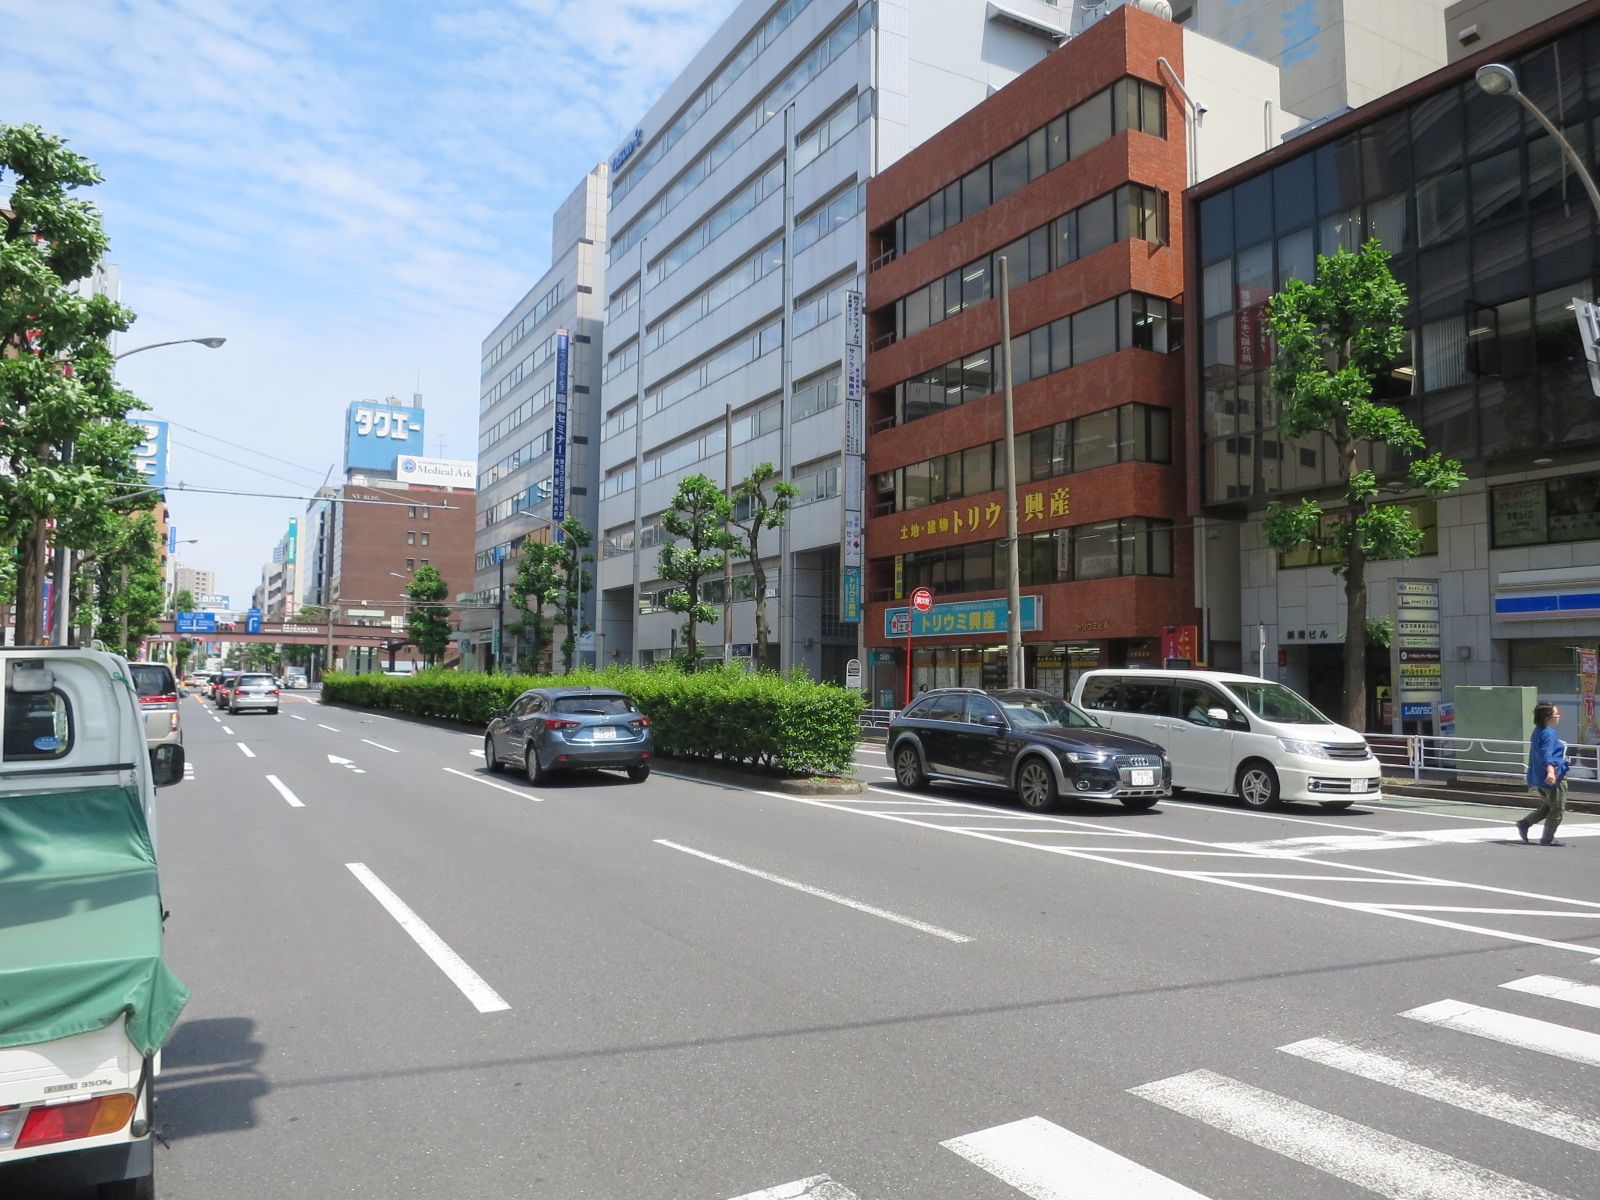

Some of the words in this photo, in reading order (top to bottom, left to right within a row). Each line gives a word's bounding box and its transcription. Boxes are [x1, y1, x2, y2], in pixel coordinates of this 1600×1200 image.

[356, 408, 421, 441] タクエー
[417, 465, 454, 477] Medical
[455, 468, 473, 478] Ark
[951, 486, 1071, 536] トリウ興産
[921, 611, 997, 632] トリウミ興産
[1404, 706, 1432, 715] LAWSO
